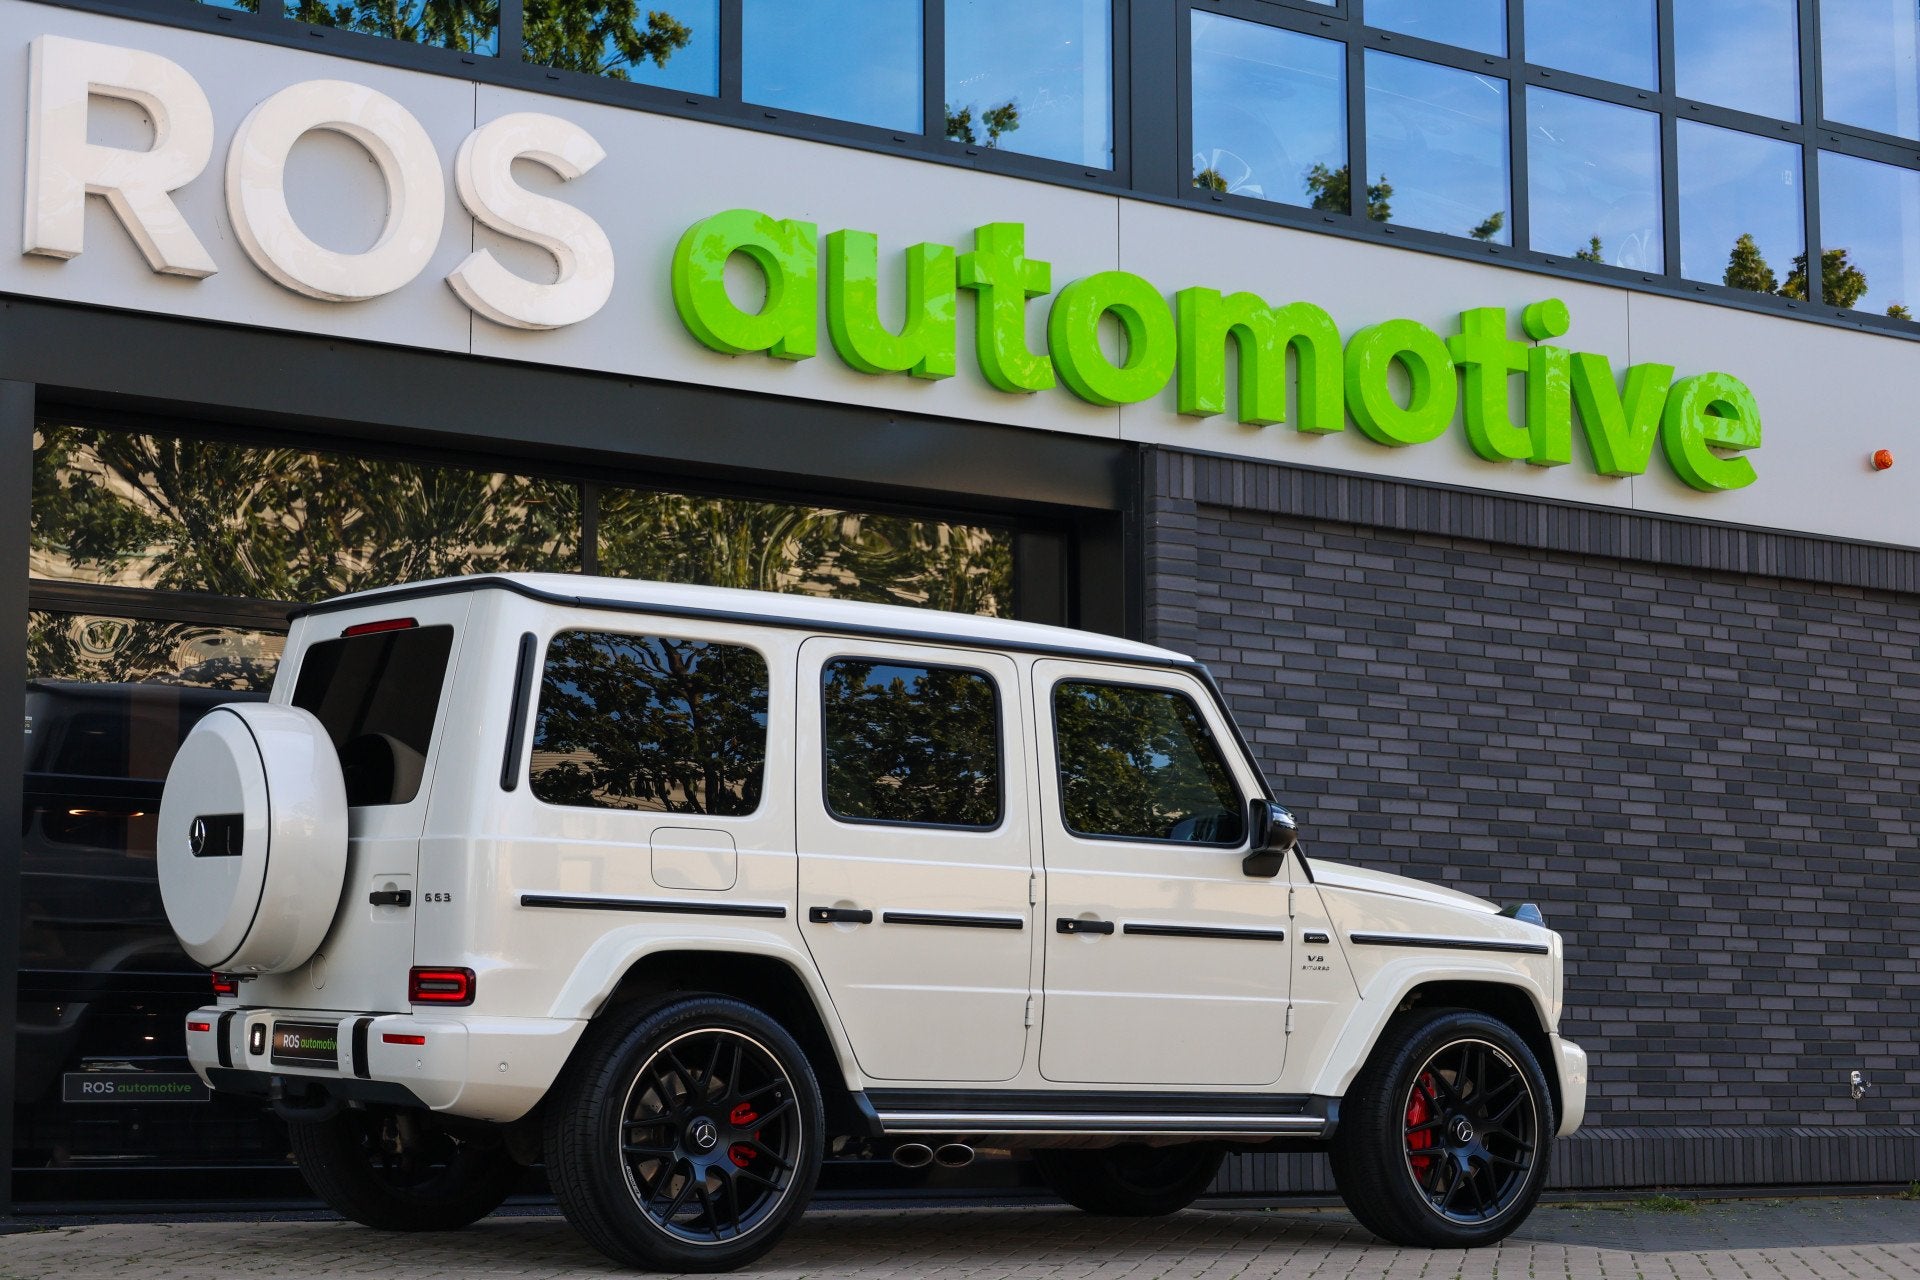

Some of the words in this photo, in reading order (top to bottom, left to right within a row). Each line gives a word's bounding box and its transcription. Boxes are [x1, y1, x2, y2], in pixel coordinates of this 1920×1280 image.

[22, 33, 616, 331] ROS
[671, 209, 1762, 493] automotive
[283, 1034, 300, 1048] ROS
[300, 1037, 338, 1050] automotiv
[82, 1081, 115, 1094] ROS
[117, 1081, 192, 1094] automotive
